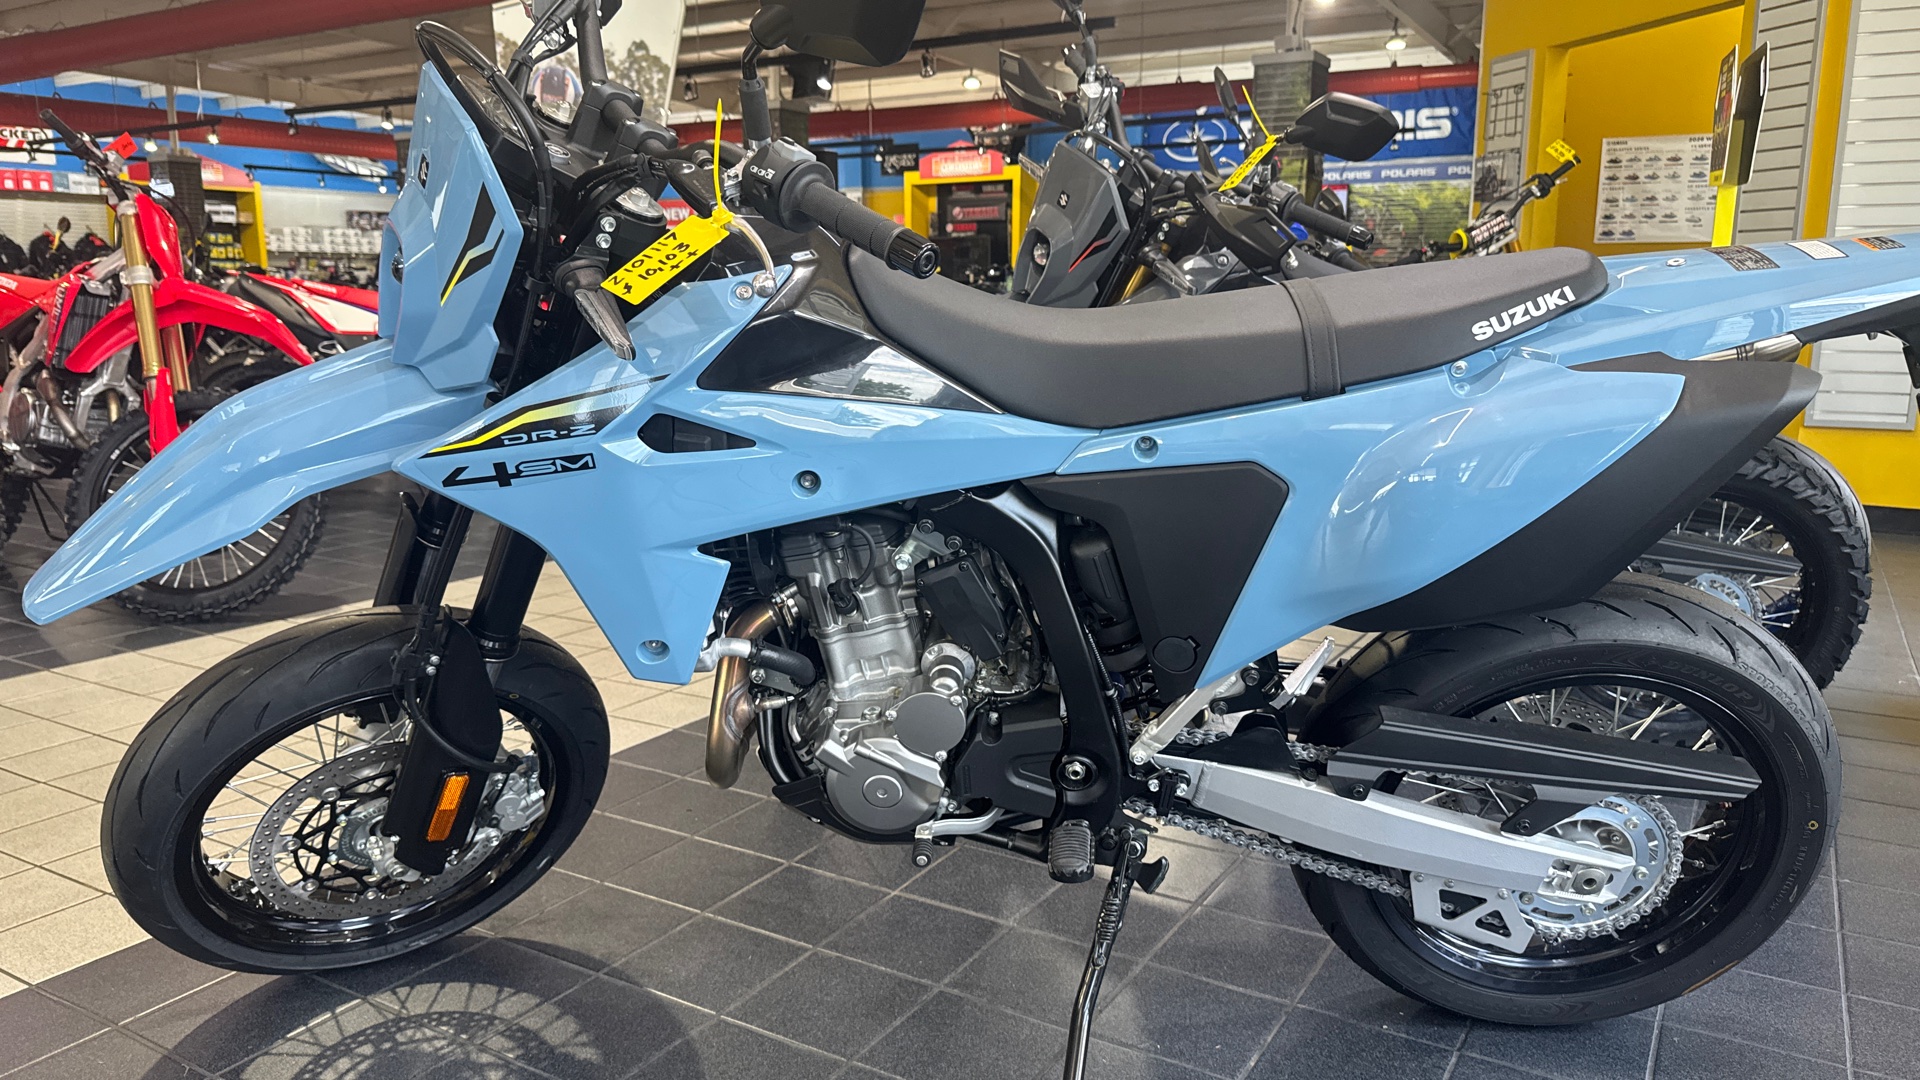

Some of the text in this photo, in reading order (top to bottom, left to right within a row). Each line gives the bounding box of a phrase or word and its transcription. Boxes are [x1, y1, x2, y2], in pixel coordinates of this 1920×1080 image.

[1381, 166, 1436, 178] POLARIS
[1471, 285, 1577, 341] SUZUKI
[500, 423, 597, 446] DR-Z
[1662, 658, 1755, 702] DUNLOP
[1737, 661, 1807, 721] SPORTMAX
